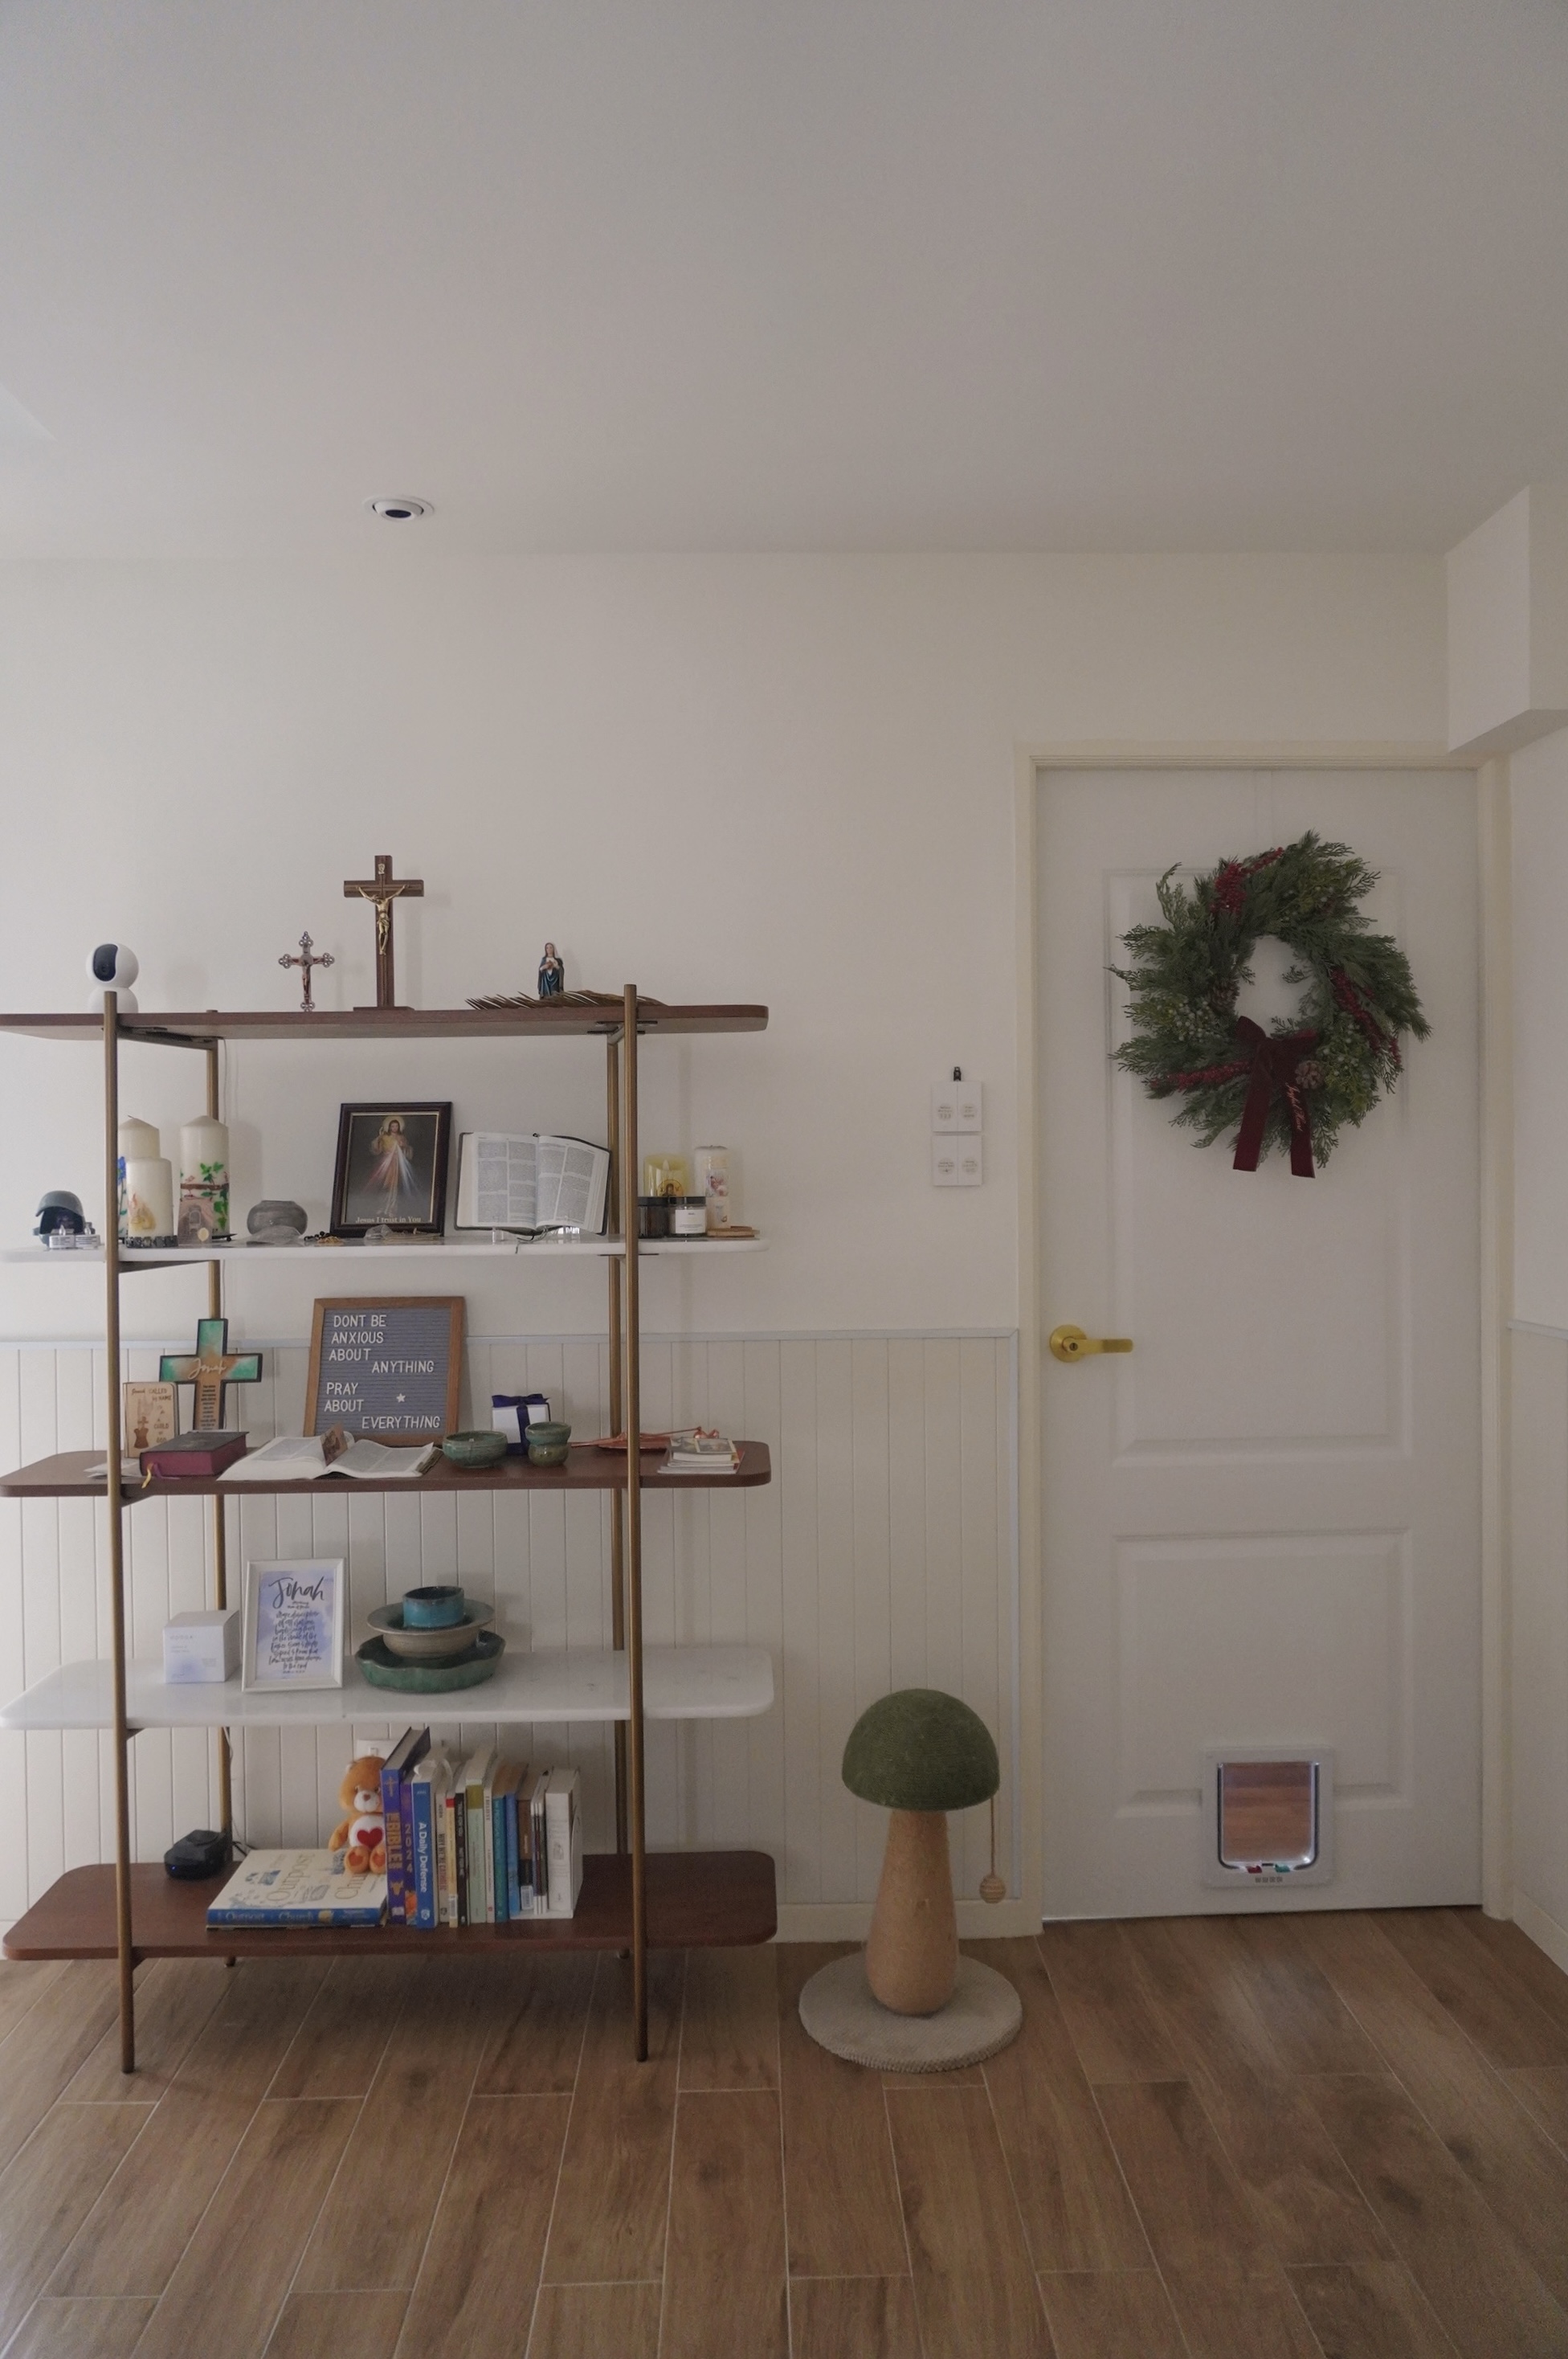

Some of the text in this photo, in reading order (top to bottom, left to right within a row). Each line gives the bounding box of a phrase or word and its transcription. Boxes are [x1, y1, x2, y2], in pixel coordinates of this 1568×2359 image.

[333, 1314, 387, 1327] DONT BE
[331, 1331, 384, 1344] ANXIOUS
[329, 1348, 372, 1361] ABOUT
[371, 1360, 435, 1374] ANYTHING
[326, 1382, 359, 1396] PRAY
[324, 1399, 365, 1413] ABOUT
[418, 1831, 428, 1855] Daily
[419, 1855, 428, 1893] Defense
